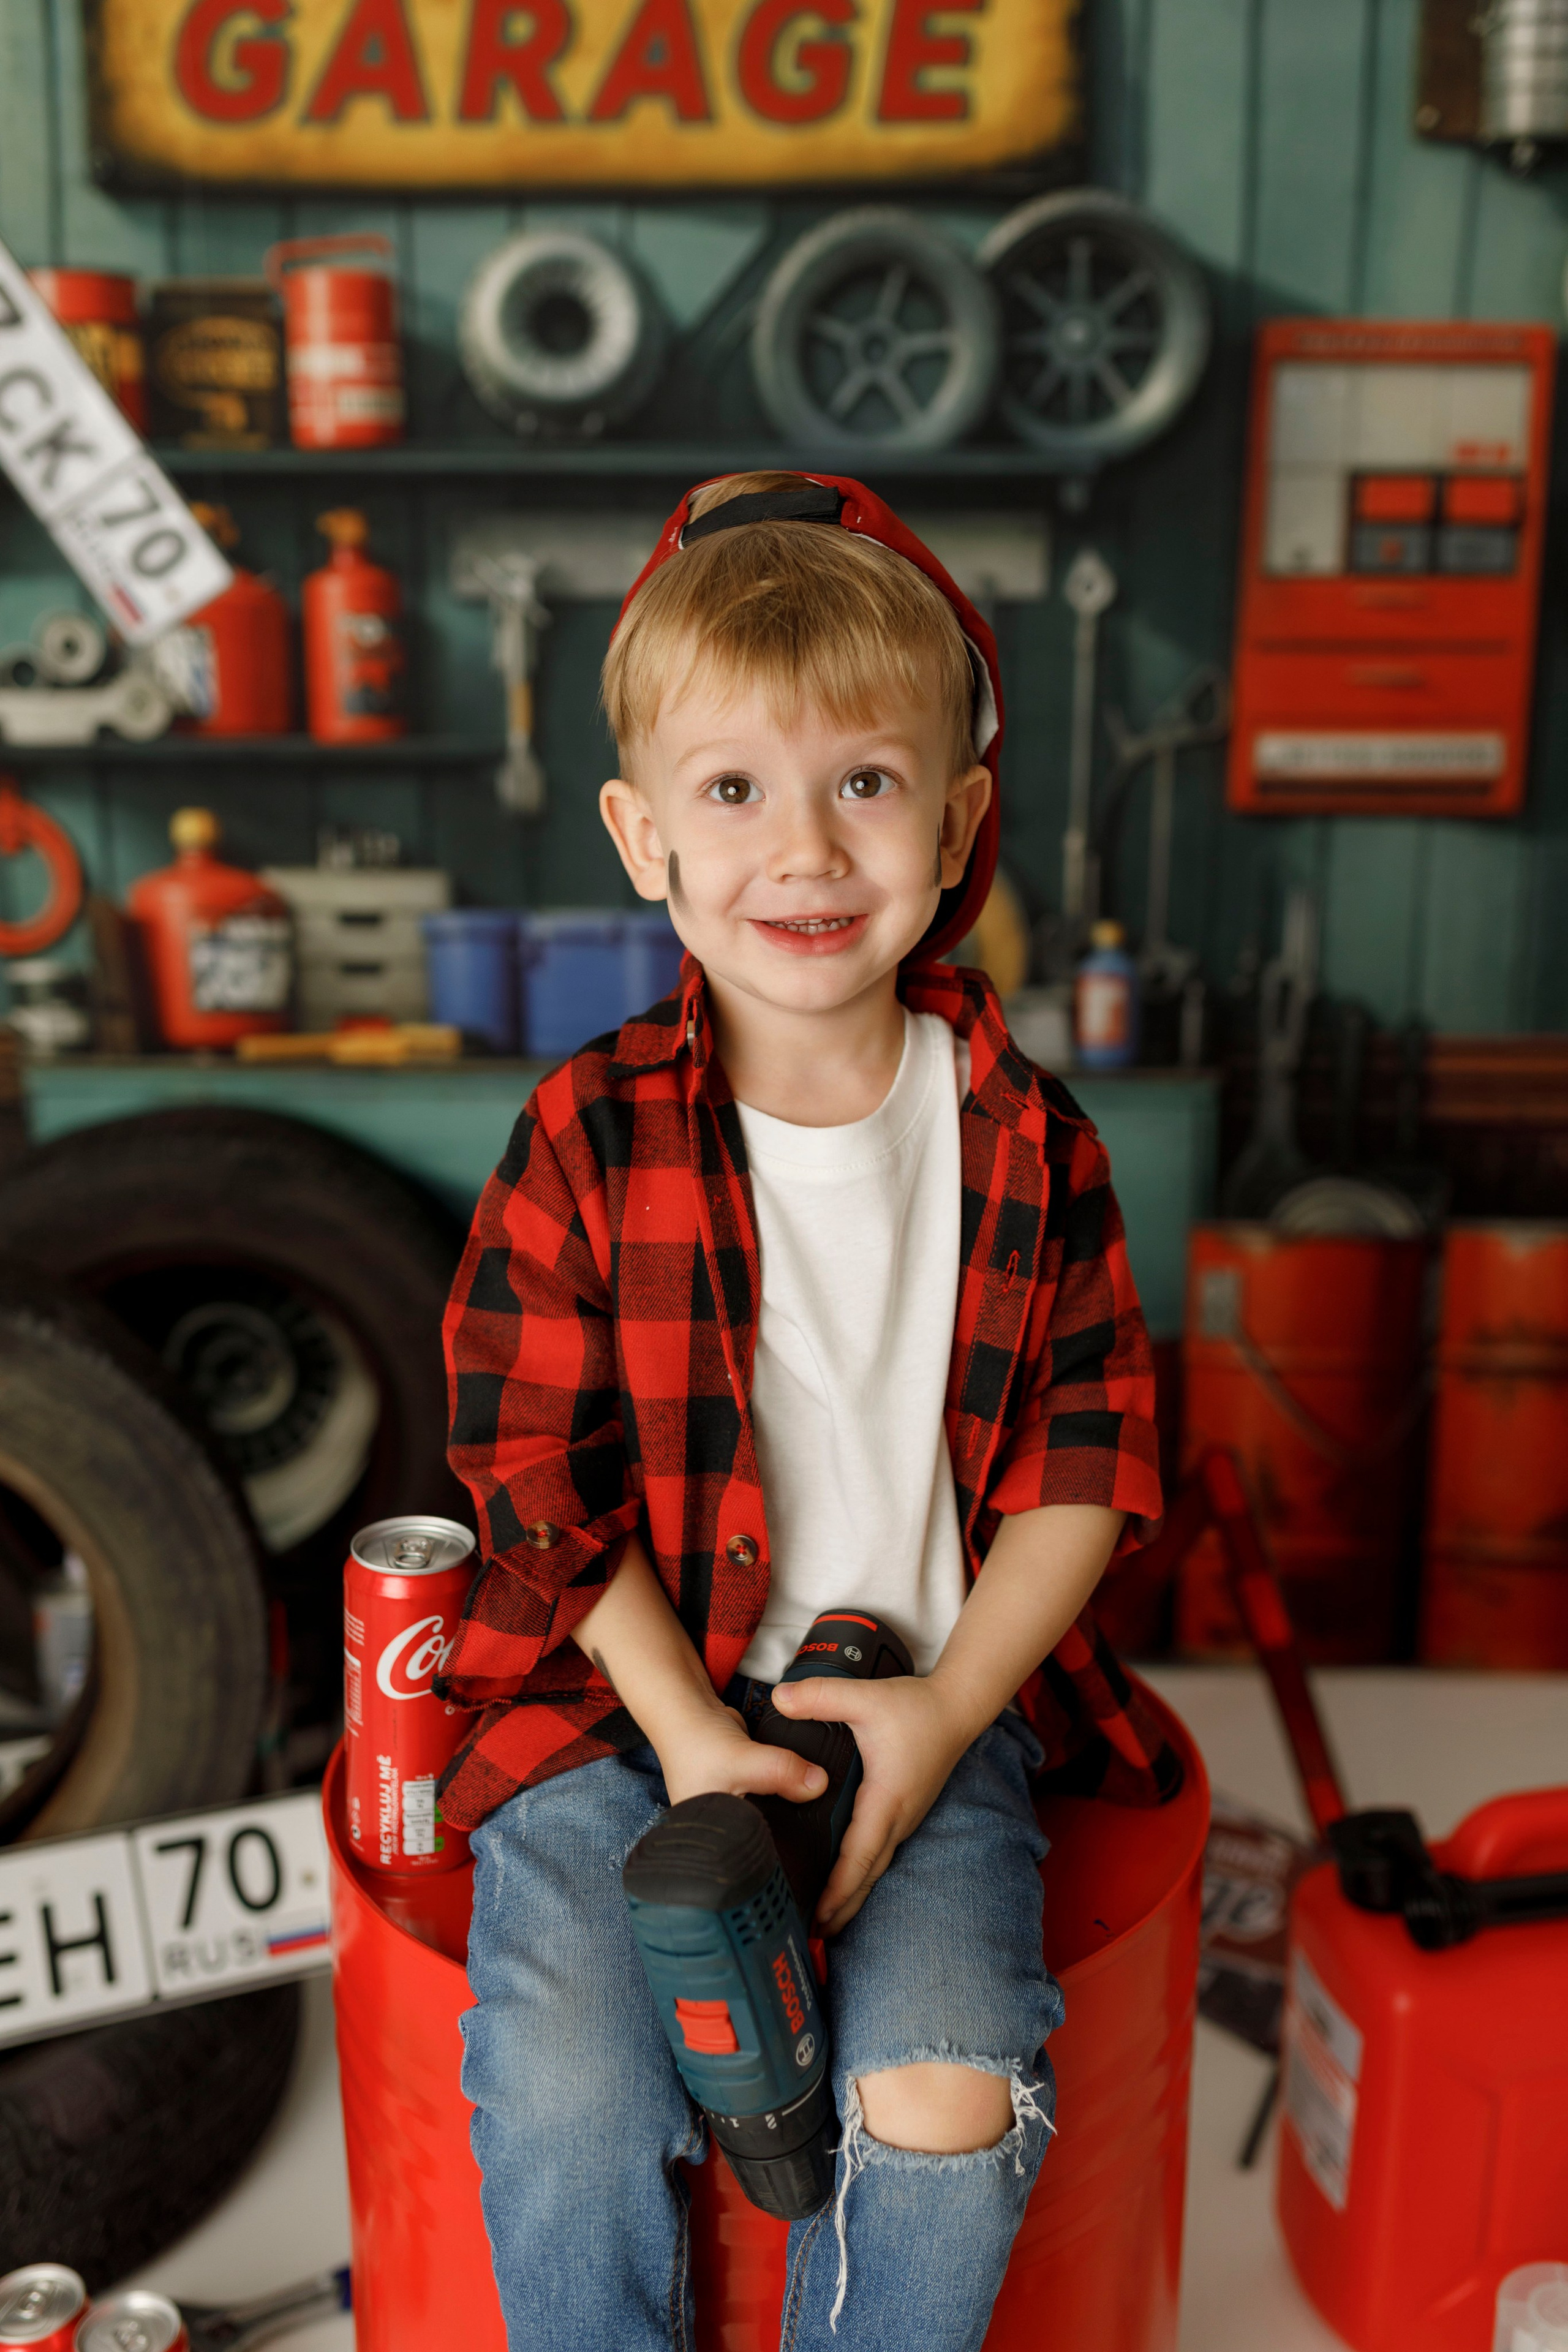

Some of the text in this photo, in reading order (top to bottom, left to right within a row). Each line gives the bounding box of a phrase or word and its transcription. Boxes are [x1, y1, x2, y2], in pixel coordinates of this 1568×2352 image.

[174, 0, 984, 127] GARAGE
[100, 475, 186, 579] 70
[794, 1642, 839, 1657] BOSC
[380, 1783, 392, 1865] RECYKLUJ
[153, 1825, 282, 1930] 70
[772, 1951, 805, 2035] BOSCH
